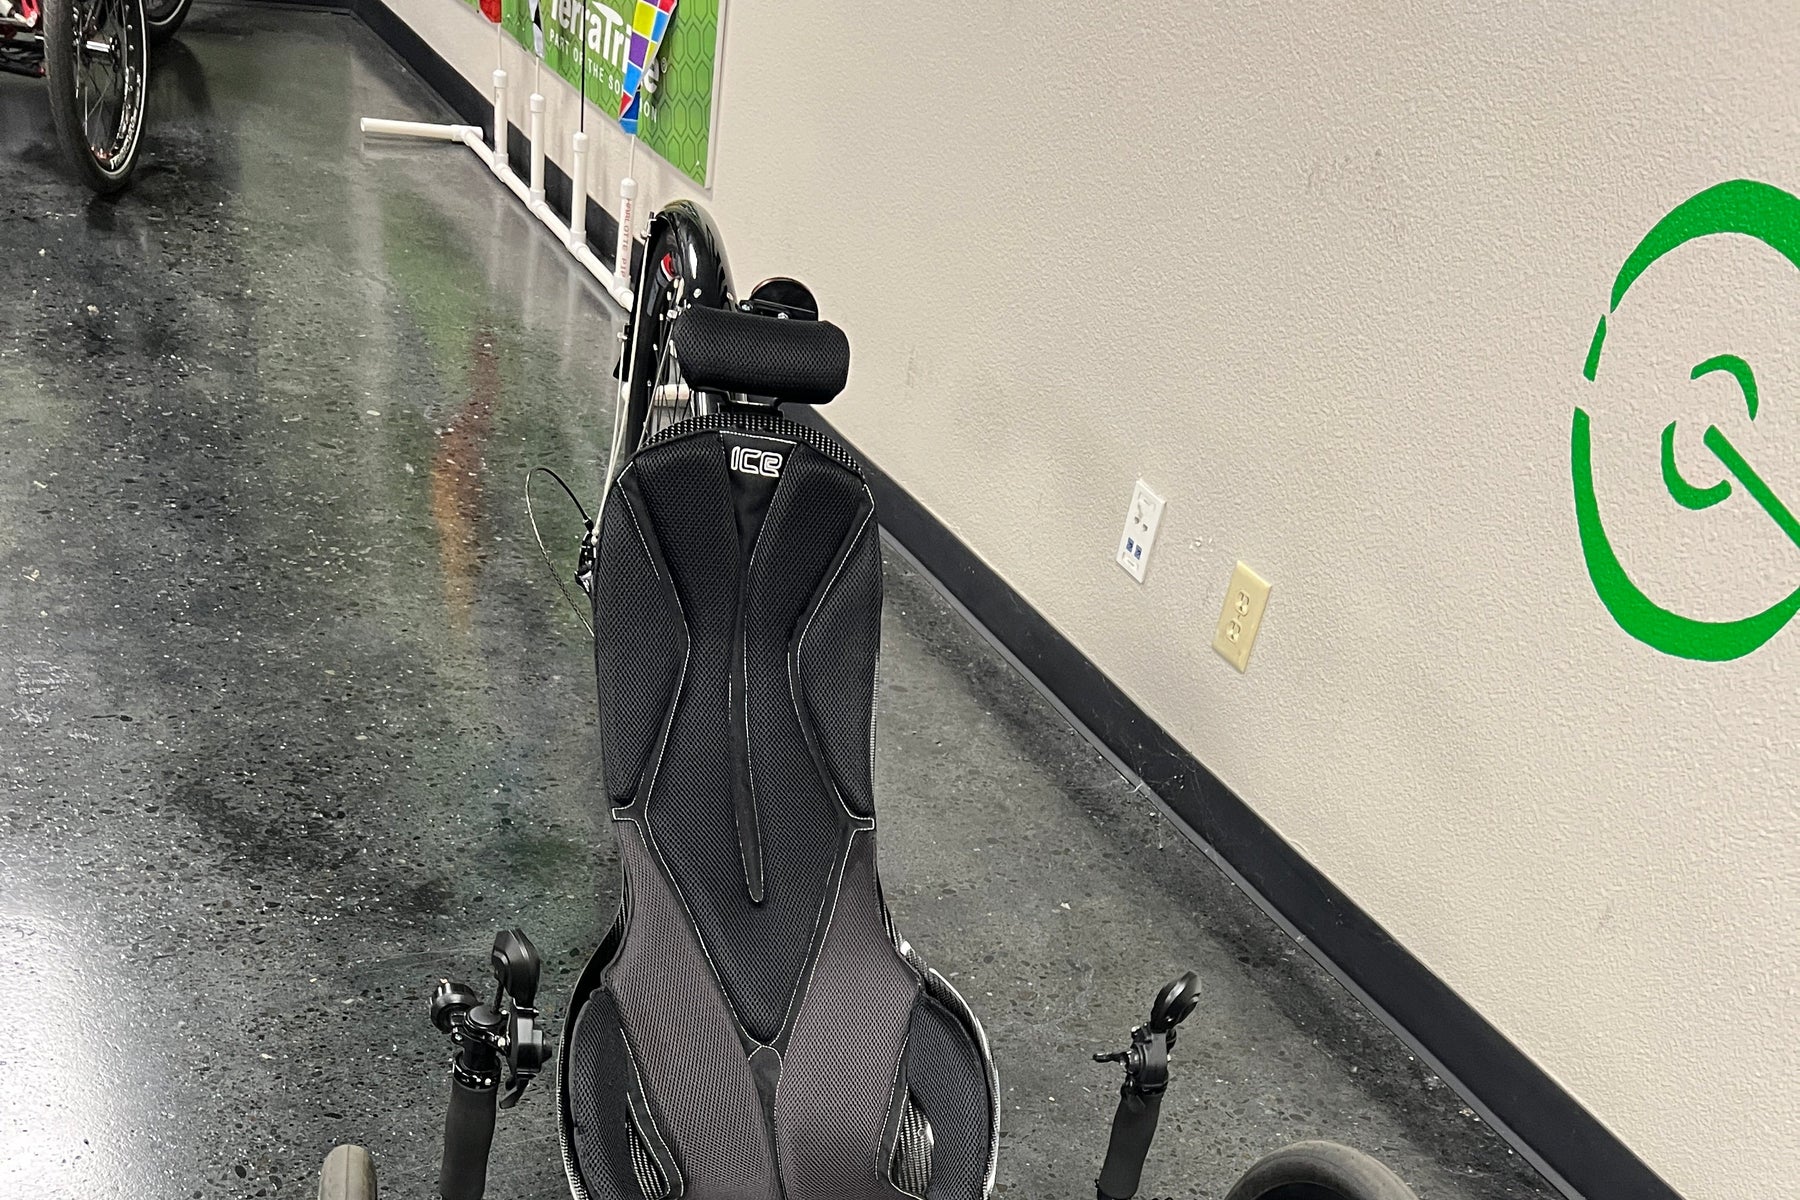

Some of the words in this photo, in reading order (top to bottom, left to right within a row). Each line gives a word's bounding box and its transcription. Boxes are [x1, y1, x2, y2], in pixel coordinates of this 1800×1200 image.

[549, 28, 570, 56] PART
[587, 58, 604, 83] THE
[608, 74, 658, 123] SOION
[551, 0, 660, 94] erraTrie
